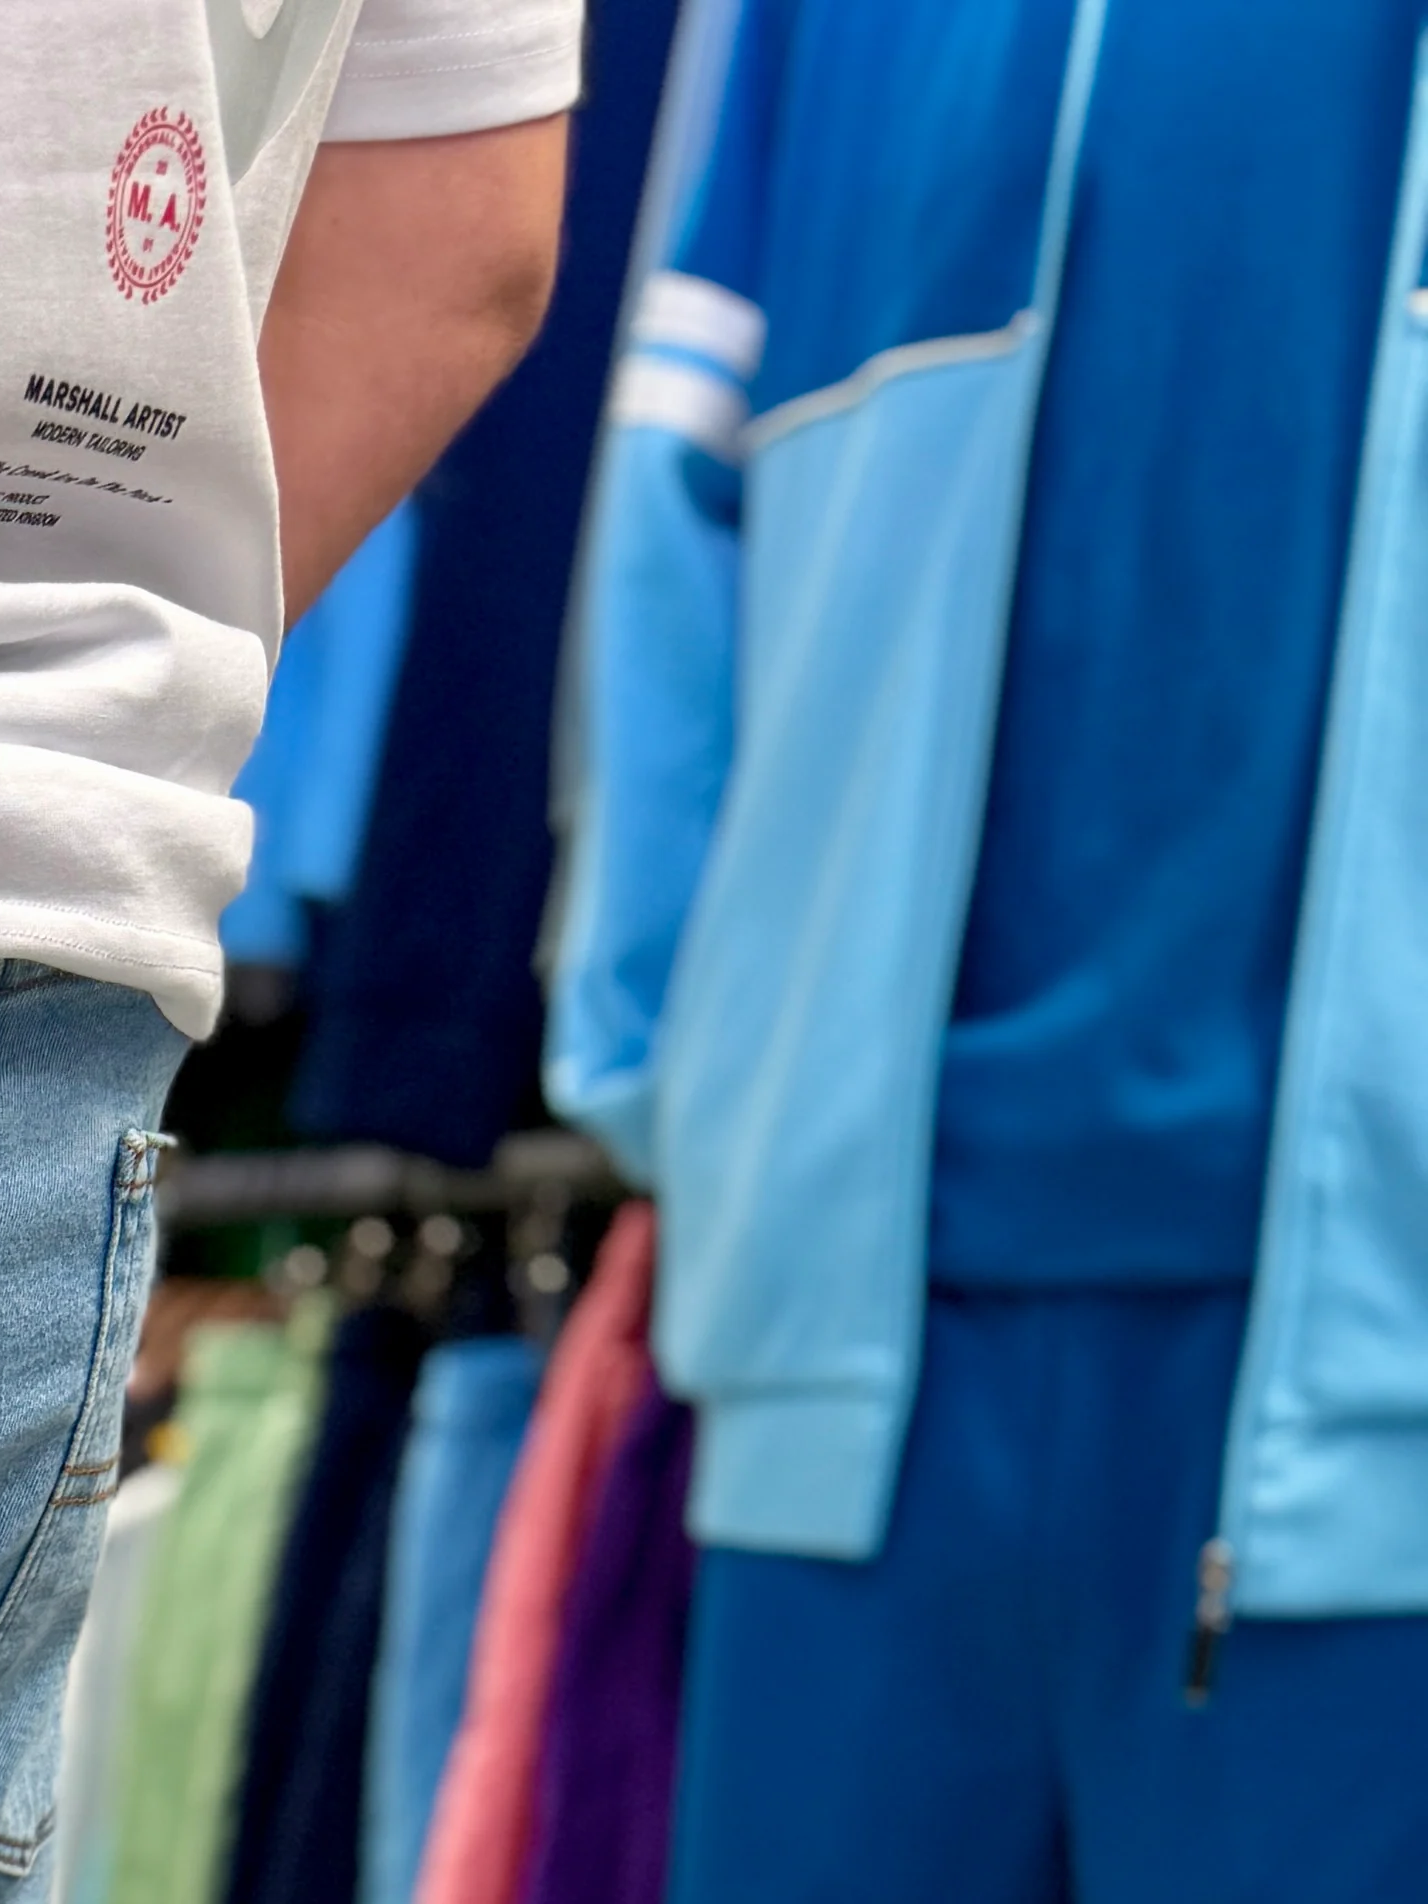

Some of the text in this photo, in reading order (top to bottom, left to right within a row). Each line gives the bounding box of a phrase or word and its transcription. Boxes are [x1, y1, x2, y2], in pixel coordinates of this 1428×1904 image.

[24, 373, 187, 440] MARSHALL ARTIST
[31, 420, 146, 462] MODERN TAILORING
[15, 512, 62, 527] KINGDOM
